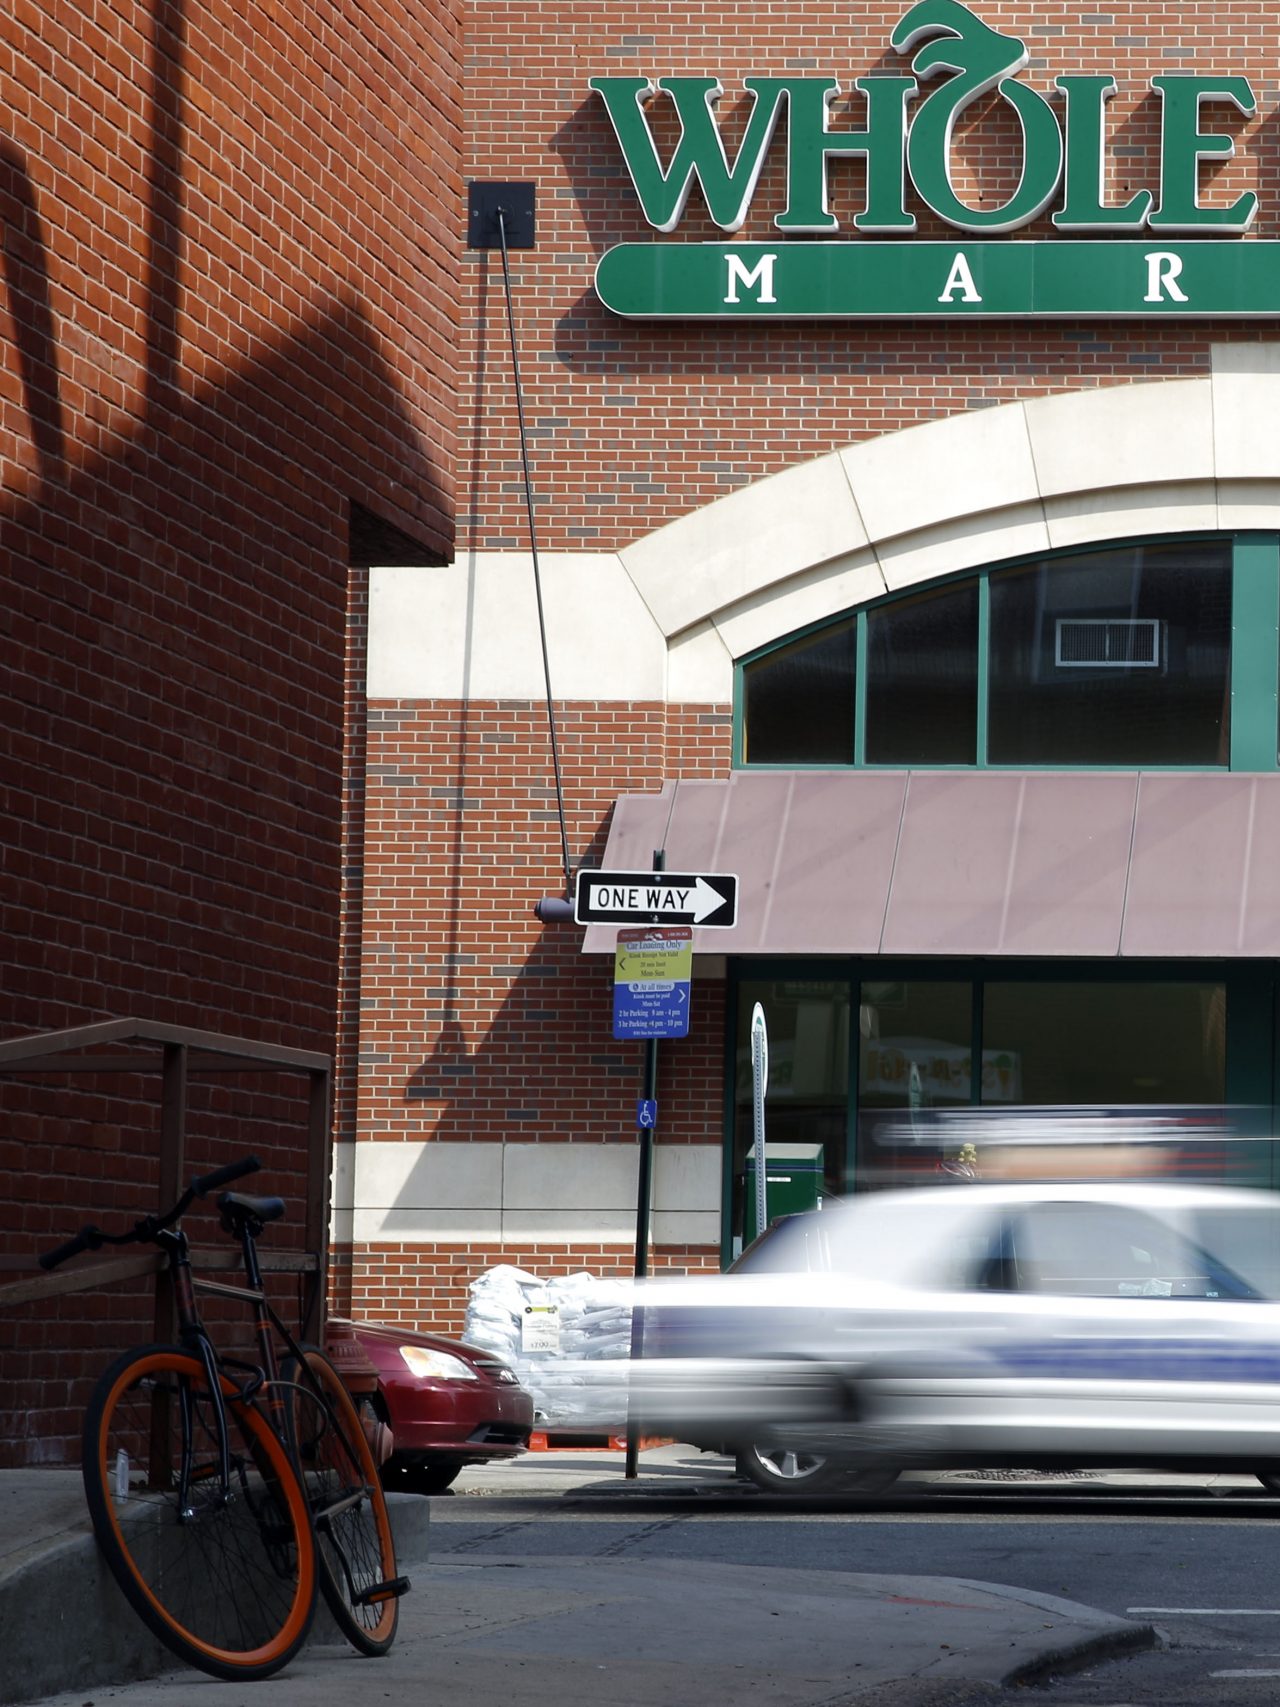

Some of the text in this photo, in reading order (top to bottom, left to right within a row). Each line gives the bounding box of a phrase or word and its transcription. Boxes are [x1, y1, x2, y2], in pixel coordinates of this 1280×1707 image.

[588, 72, 1258, 234] WHOLE
[597, 887, 690, 909] ONE WAY
[639, 941, 665, 951] Loading
[666, 940, 681, 950] Only
[630, 1010, 648, 1018] Parking
[629, 1020, 648, 1028] Parking
